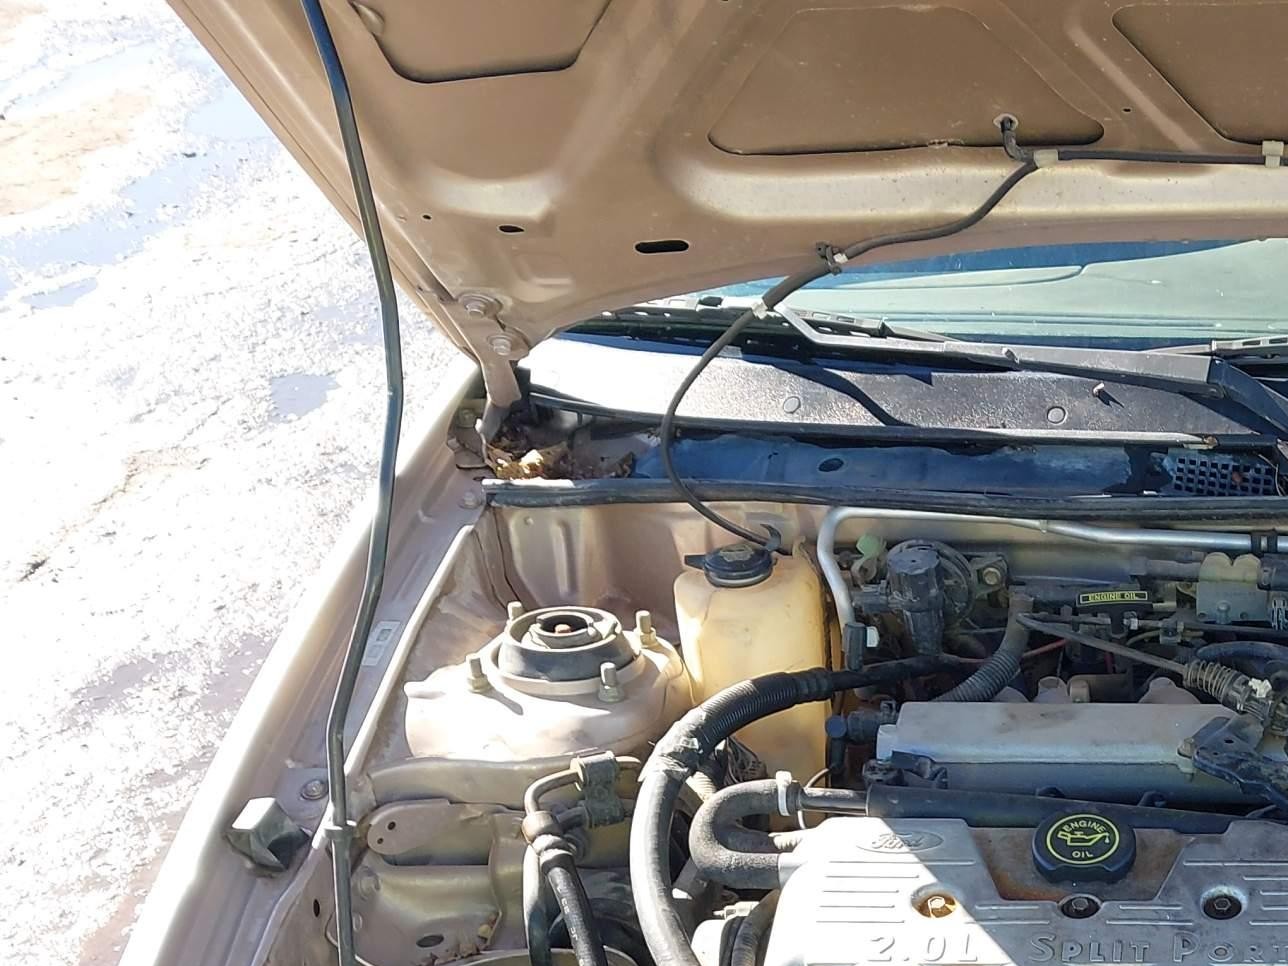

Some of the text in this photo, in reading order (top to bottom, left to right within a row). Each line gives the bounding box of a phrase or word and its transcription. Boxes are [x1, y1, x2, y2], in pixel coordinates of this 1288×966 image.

[1088, 592, 1141, 602] ENGINE OIL
[1061, 820, 1107, 833] ENGINE
[1072, 850, 1094, 858] OIL
[867, 933, 978, 962] 2.0L
[1028, 932, 1150, 962] SPLIT
